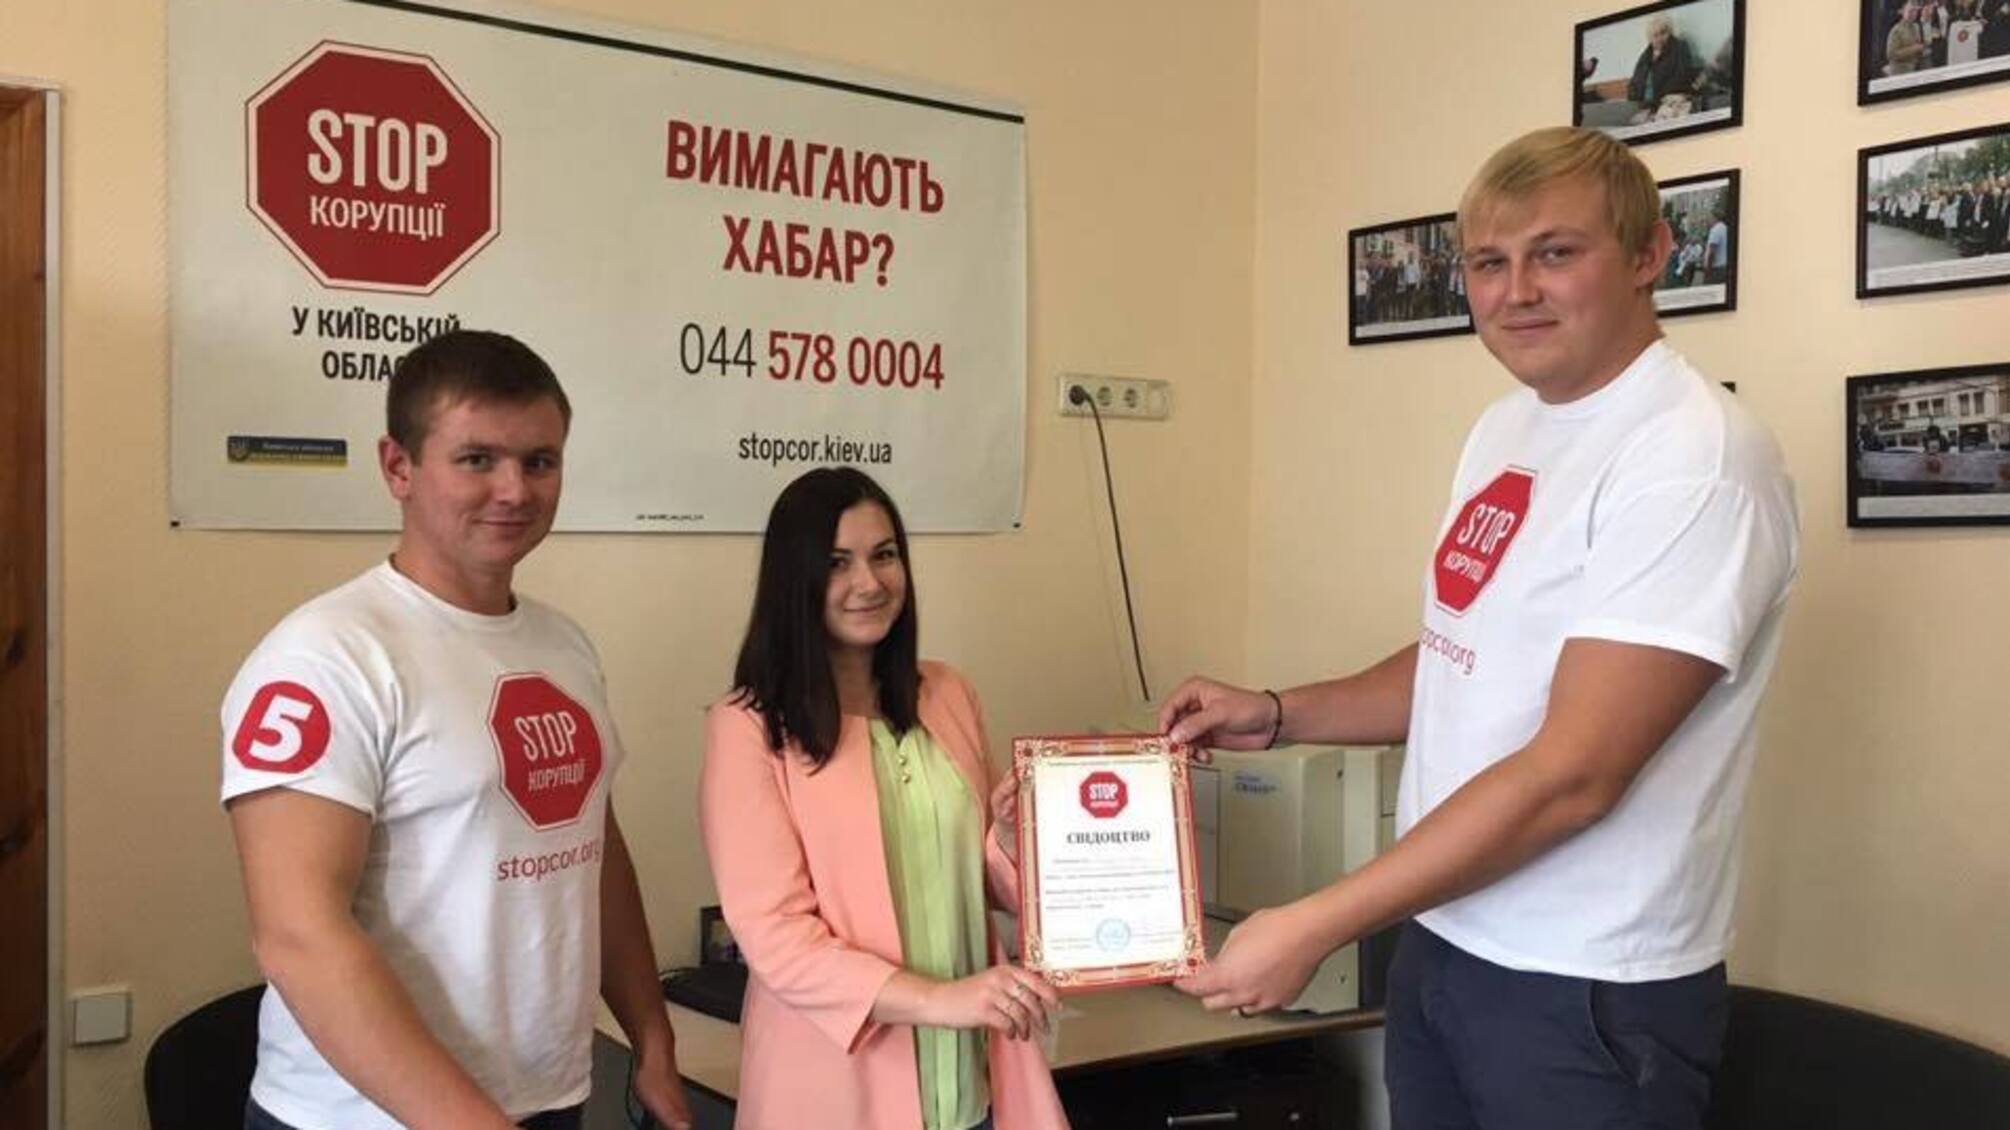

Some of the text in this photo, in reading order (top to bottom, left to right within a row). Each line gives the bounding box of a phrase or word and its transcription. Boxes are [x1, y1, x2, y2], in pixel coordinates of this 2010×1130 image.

[306, 108, 448, 195] STOP
[666, 120, 945, 214] ВИМАГАЮТЬ
[310, 196, 446, 241] КОРУПЦІЇ
[722, 215, 895, 286] ХАБАР?
[292, 306, 460, 343] У КИЇВСЬКІЙ
[322, 350, 406, 381] ОБЛА
[680, 322, 945, 390] 044 578 0004
[738, 432, 893, 467] stopcor.kiev.ua
[1456, 503, 1516, 556] STOP
[249, 694, 313, 764] 5
[513, 709, 578, 762] STOP
[1089, 783, 1119, 800] STOP
